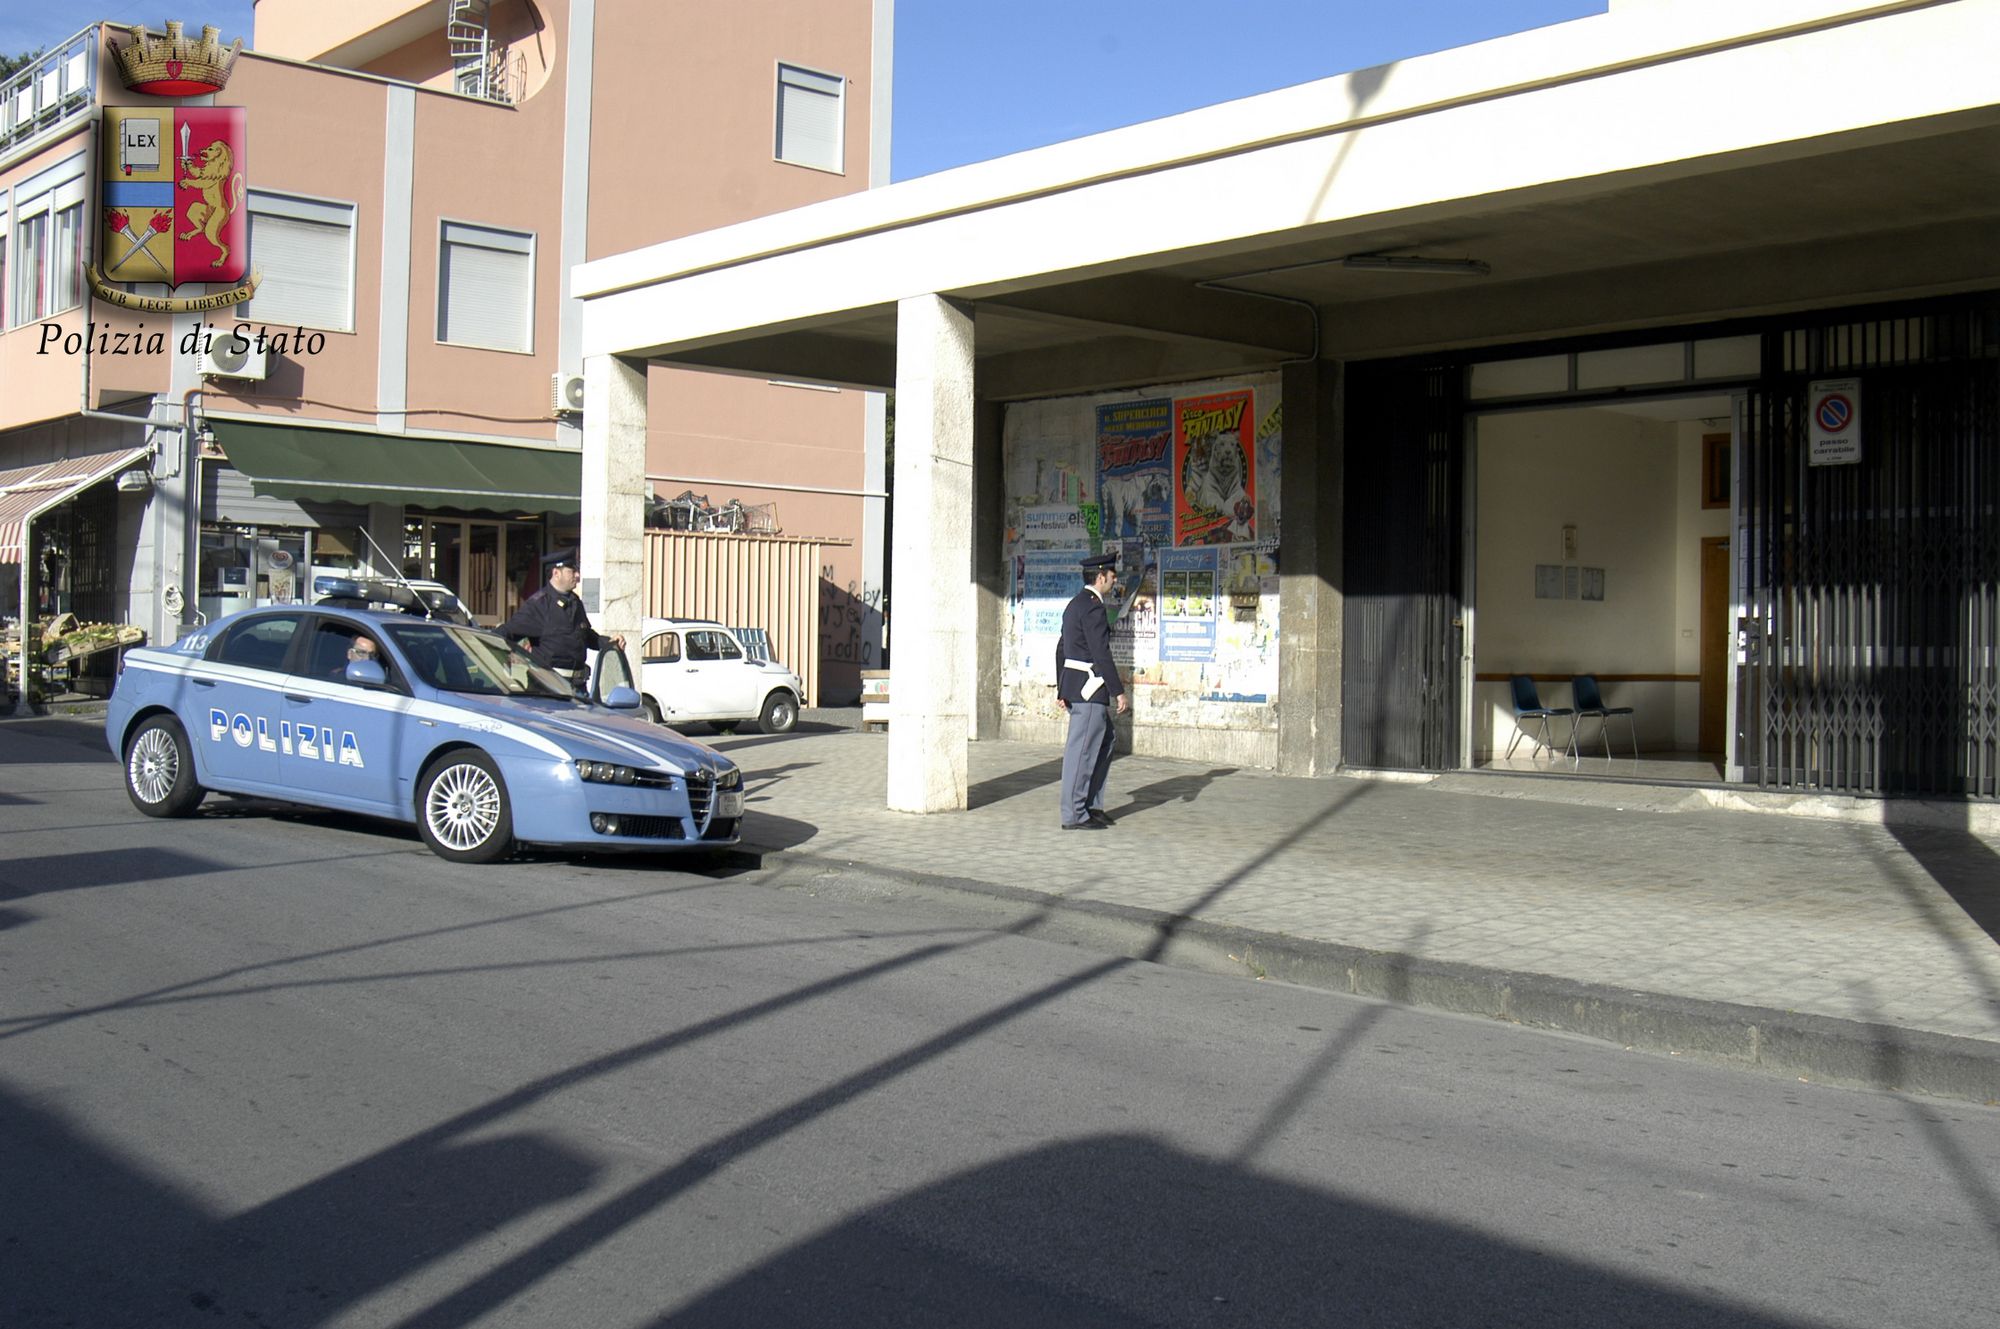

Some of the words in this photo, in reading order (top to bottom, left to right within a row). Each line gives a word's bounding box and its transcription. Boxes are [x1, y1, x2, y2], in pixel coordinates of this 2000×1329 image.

[1182, 399, 1247, 445] FANTASY
[1819, 438, 1849, 448] passo
[1814, 445, 1855, 455] carrabile
[1025, 511, 1070, 523] summer
[1041, 520, 1069, 530] festival
[182, 634, 209, 651] 113
[209, 708, 365, 769] POLIZIA
